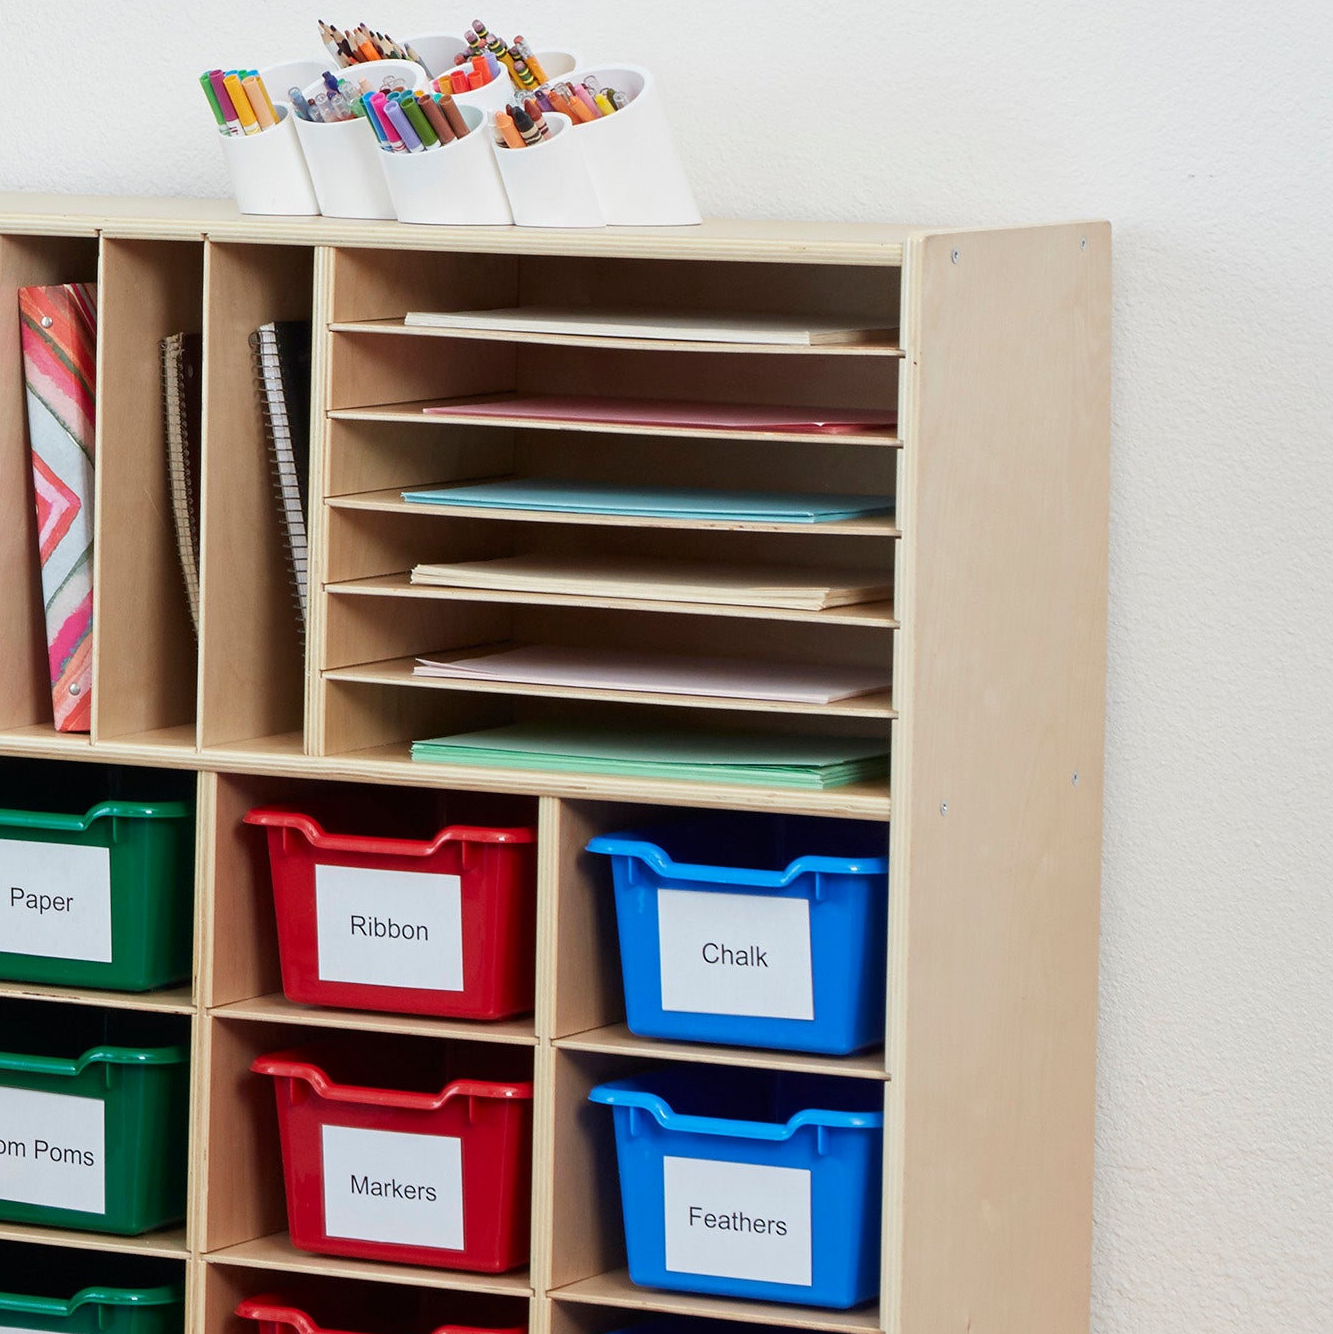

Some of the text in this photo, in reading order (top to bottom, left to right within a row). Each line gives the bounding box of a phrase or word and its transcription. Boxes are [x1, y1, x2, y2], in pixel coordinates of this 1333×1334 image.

[10, 886, 74, 915] Paper
[350, 914, 429, 942] Ribbon
[702, 942, 769, 968] Chalk
[34, 1138, 95, 1167] Poms
[350, 1174, 437, 1202] Markers
[689, 1206, 788, 1236] Feathers
